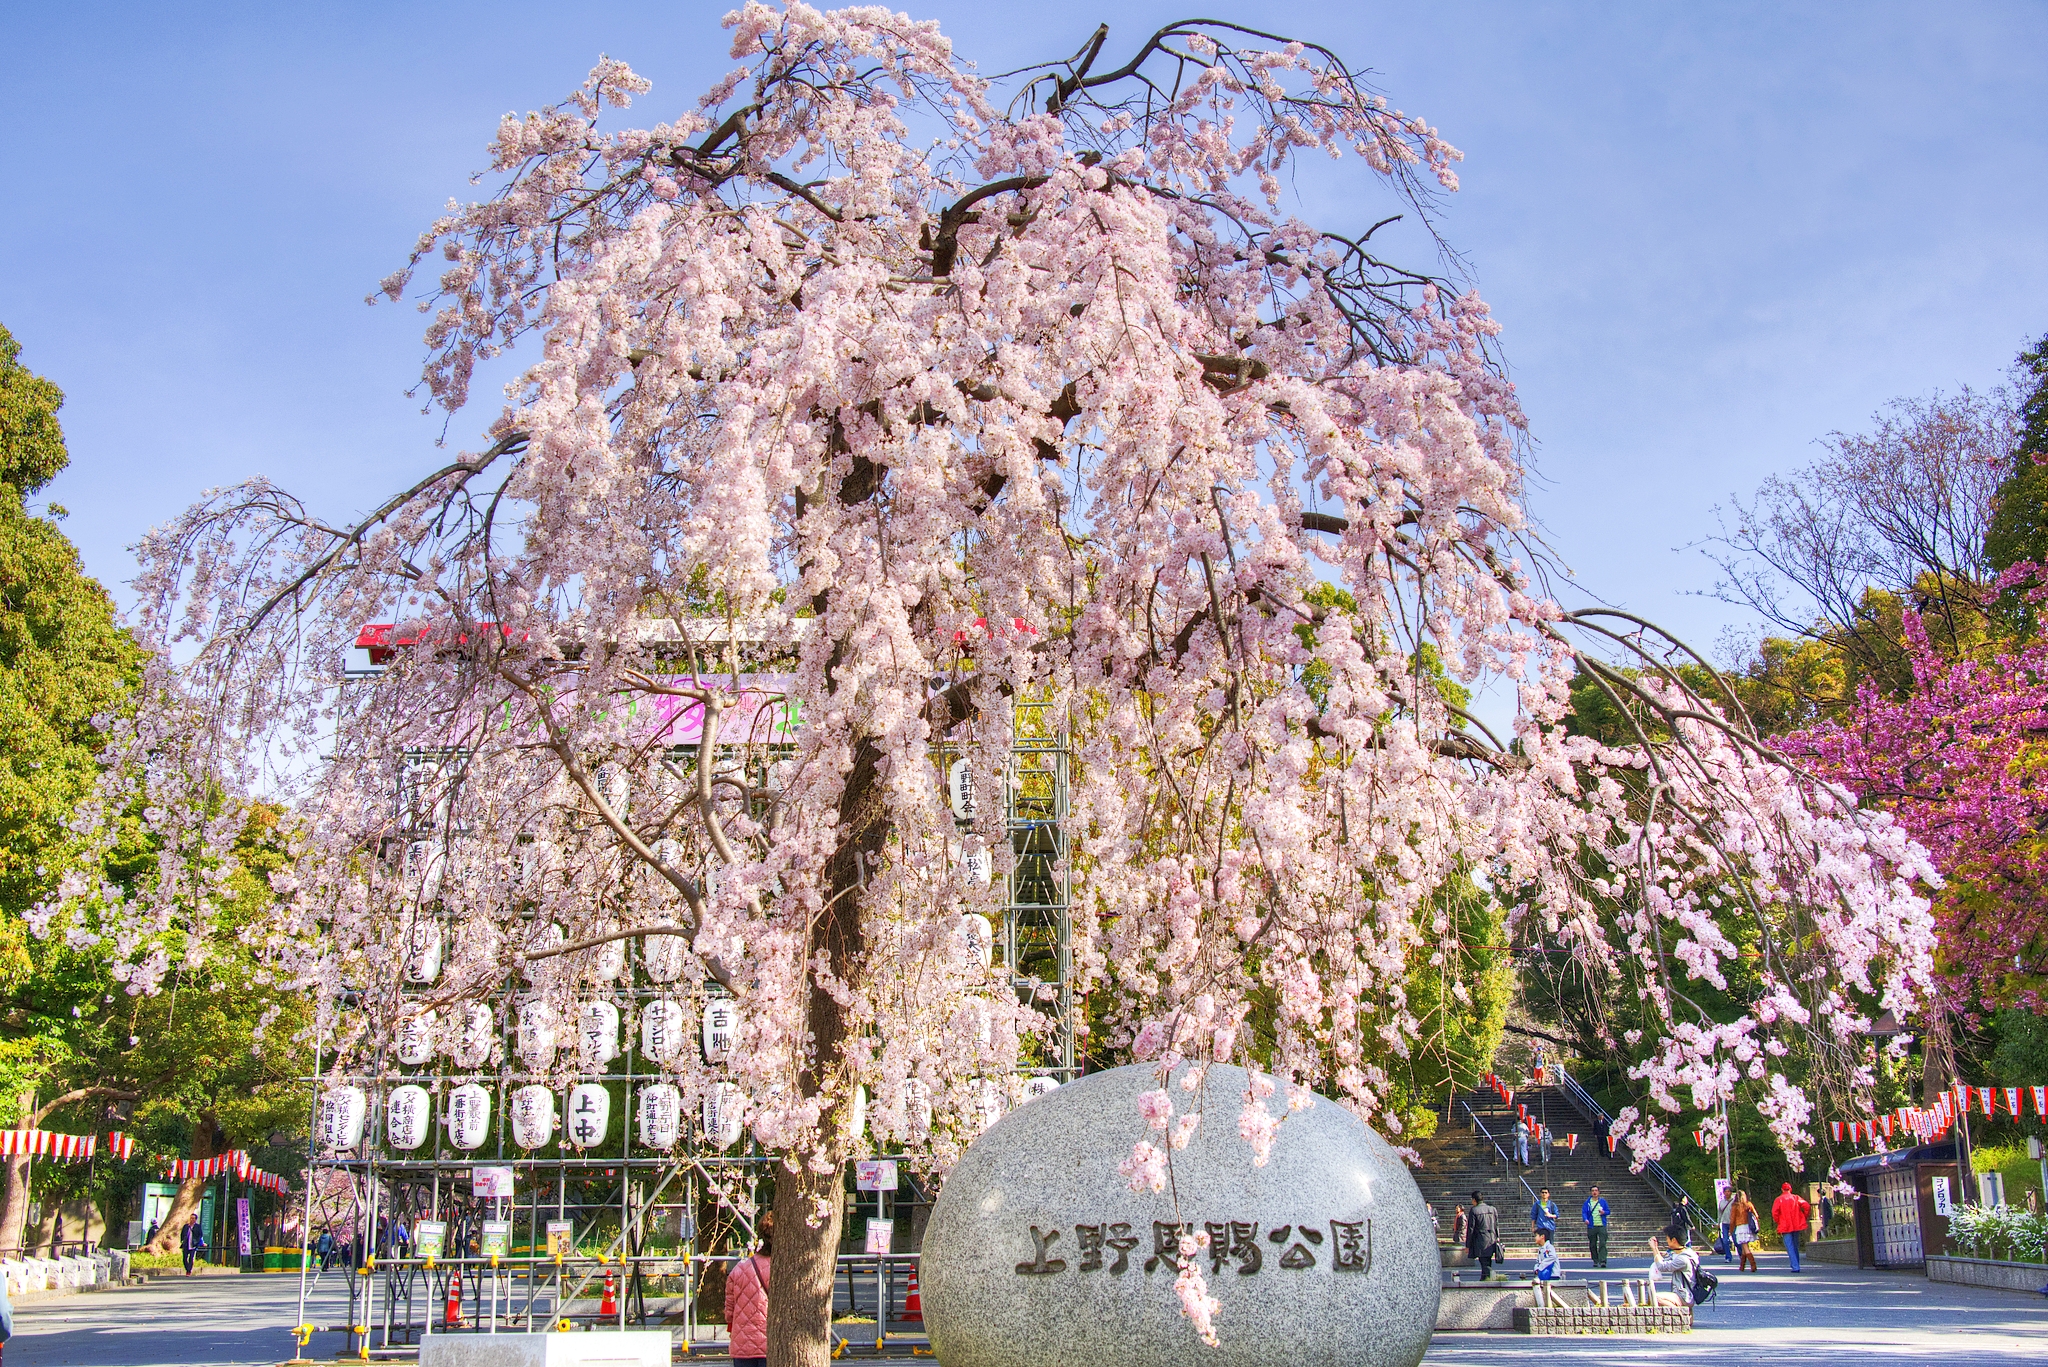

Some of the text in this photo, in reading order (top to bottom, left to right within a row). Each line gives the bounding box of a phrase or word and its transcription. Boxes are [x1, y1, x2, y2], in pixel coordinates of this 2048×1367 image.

[712, 1008, 731, 1053] 吉池
[390, 1100, 401, 1145] 連合会
[402, 1090, 417, 1145] アメ横商店街
[468, 1090, 481, 1131] 上野駅前
[575, 1094, 597, 1143] 上中
[1936, 1178, 1946, 1213] コインロッカー
[1014, 1218, 1372, 1276] 上野恩賜公園
